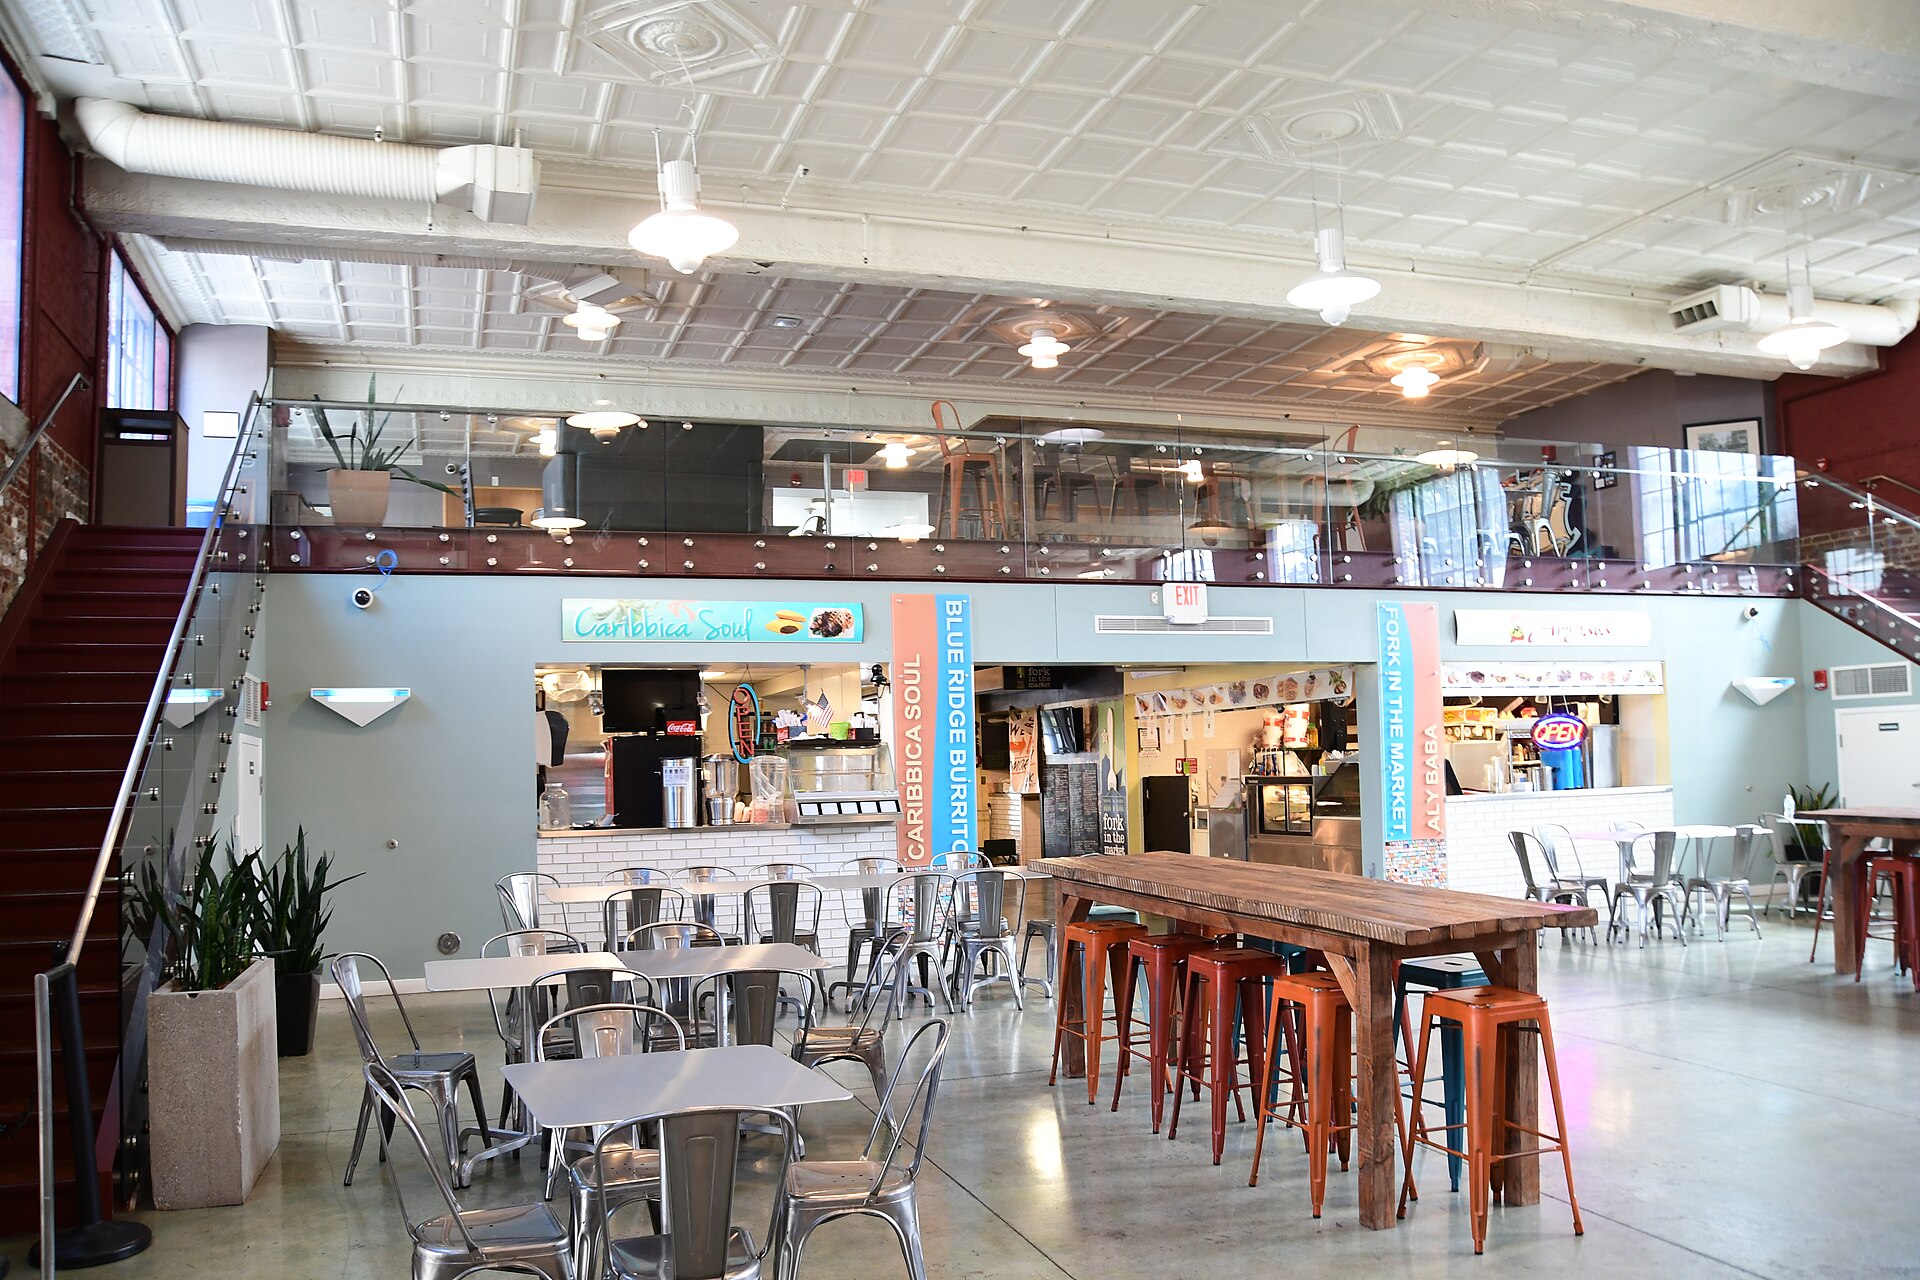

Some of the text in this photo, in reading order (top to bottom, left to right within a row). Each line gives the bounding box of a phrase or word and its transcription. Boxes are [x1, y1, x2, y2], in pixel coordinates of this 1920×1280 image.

[1175, 585, 1199, 606] EXIT
[574, 607, 753, 642] Caribbica Soul
[945, 600, 964, 664] BLUE
[1028, 667, 1051, 676] fork
[948, 669, 967, 744] RIDGE
[1386, 607, 1407, 834] FORK IN THE MARKET
[667, 723, 694, 733] Coca-Cola
[733, 687, 755, 756] OPEN
[1537, 724, 1583, 742] OPEN
[903, 653, 925, 860] CARIBBICA SOUL
[1424, 724, 1441, 835] ALY BABA
[1103, 813, 1124, 831] fork
[1104, 832, 1125, 844] in the
[1104, 844, 1125, 856] market
